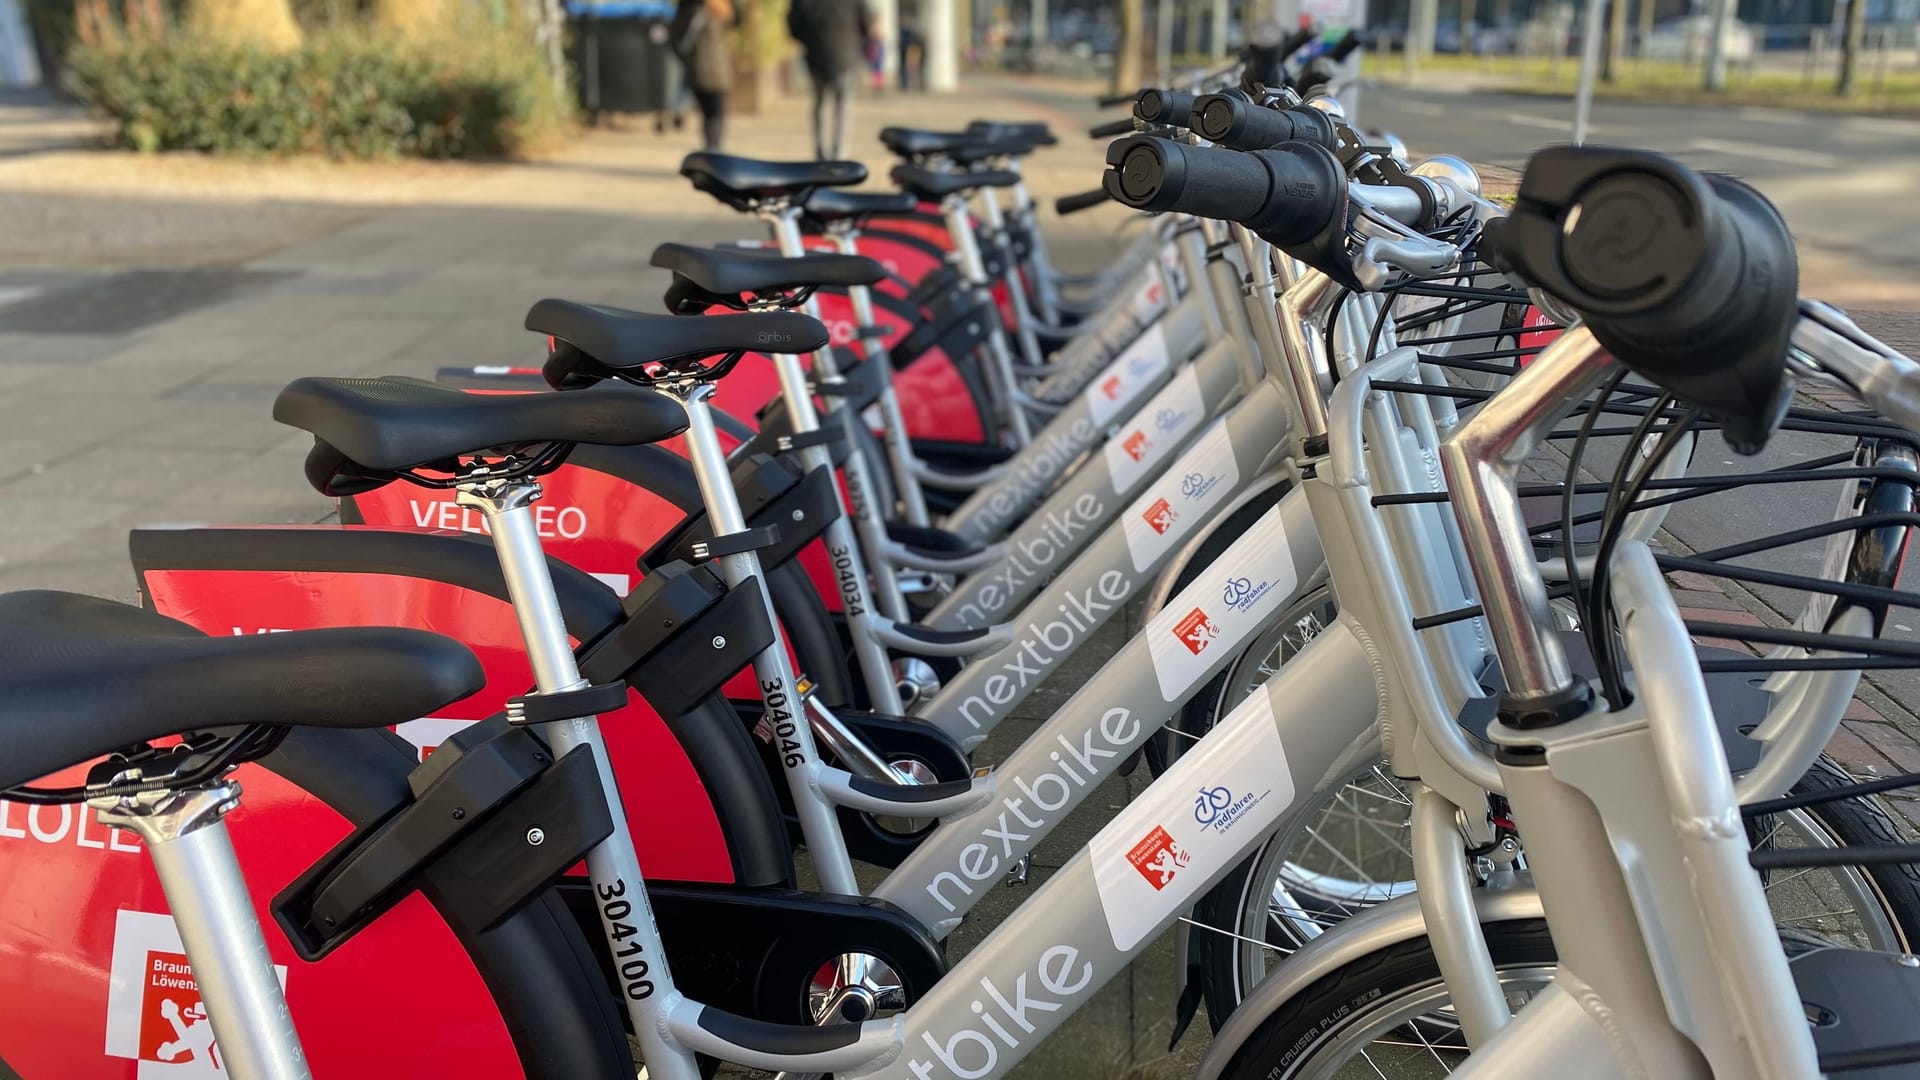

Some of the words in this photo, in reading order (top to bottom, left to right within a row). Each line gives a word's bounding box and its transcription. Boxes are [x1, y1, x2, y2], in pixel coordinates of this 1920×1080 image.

[410, 500, 587, 539] VELEO
[831, 546, 866, 618] 304034
[1237, 581, 1268, 610] radfahren
[958, 570, 1130, 729] nextbike
[761, 676, 805, 769] 304046
[926, 707, 1141, 913] nextbike
[1214, 792, 1254, 830] radfahren
[597, 878, 655, 1001] 304100
[1280, 1027, 1320, 1066] CRUISER
[1320, 1005, 1350, 1029] PLUS
